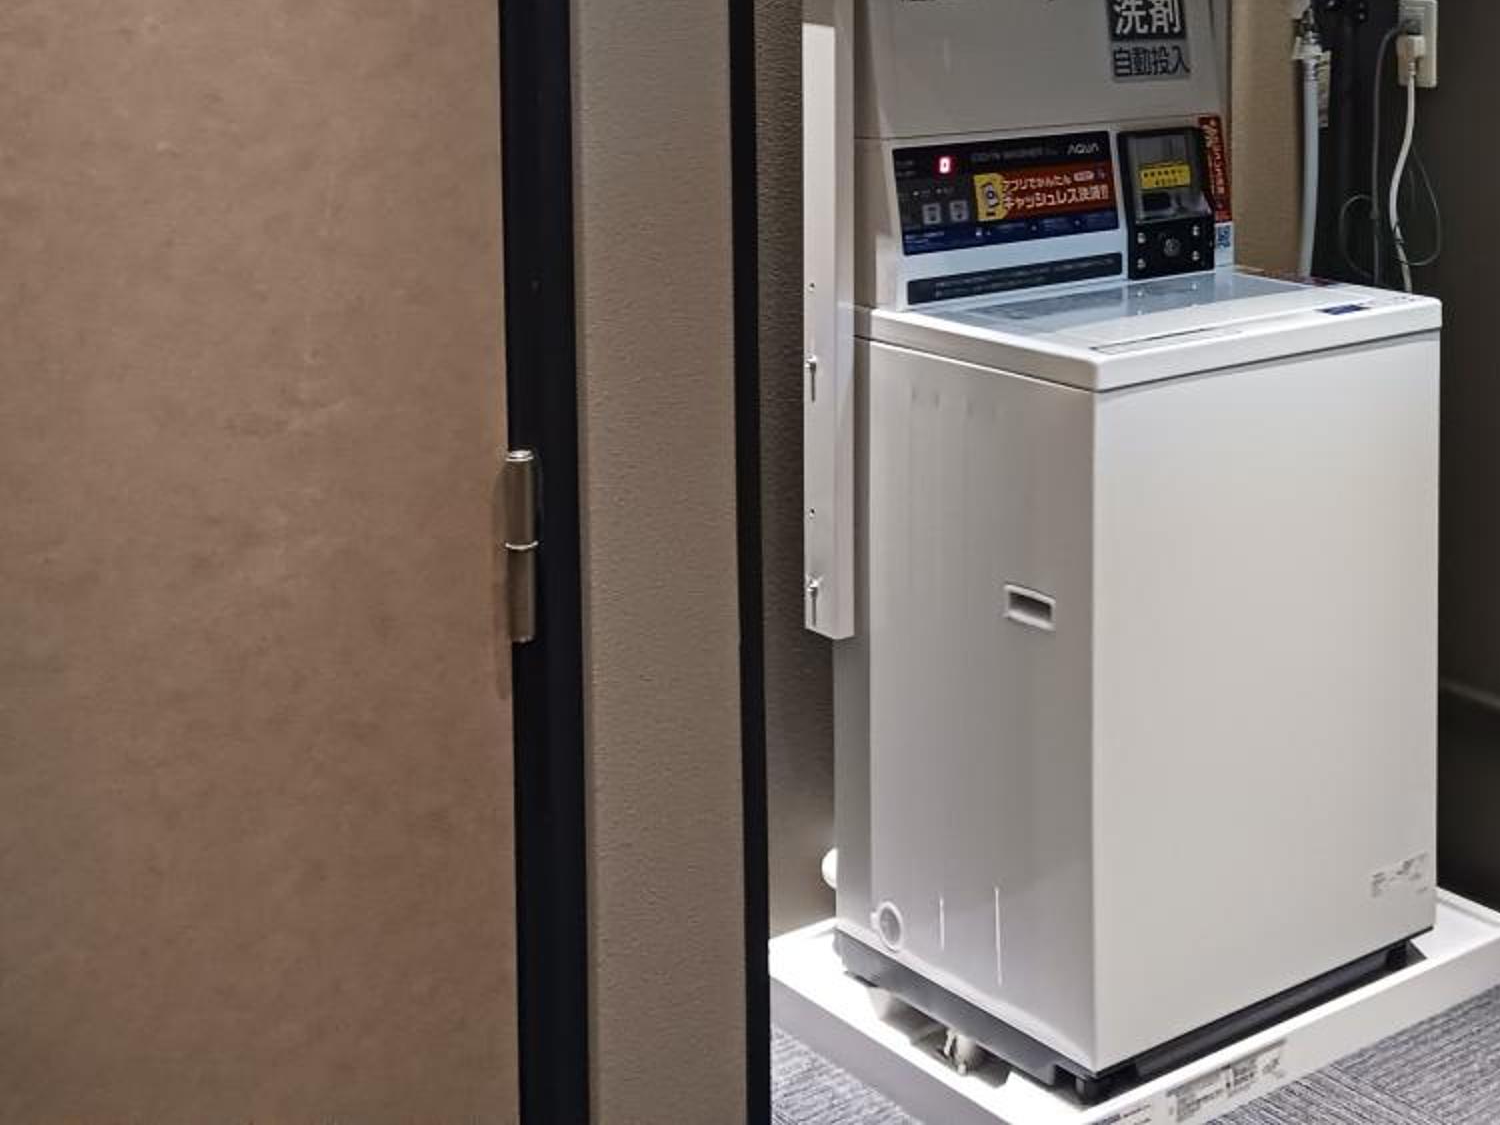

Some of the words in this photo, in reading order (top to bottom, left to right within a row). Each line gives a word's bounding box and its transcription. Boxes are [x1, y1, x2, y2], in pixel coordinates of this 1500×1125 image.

[1113, 44, 1191, 77] 自動投入
[1067, 142, 1100, 155] AQUA
[1003, 173, 1073, 192] アプリでかんたん
